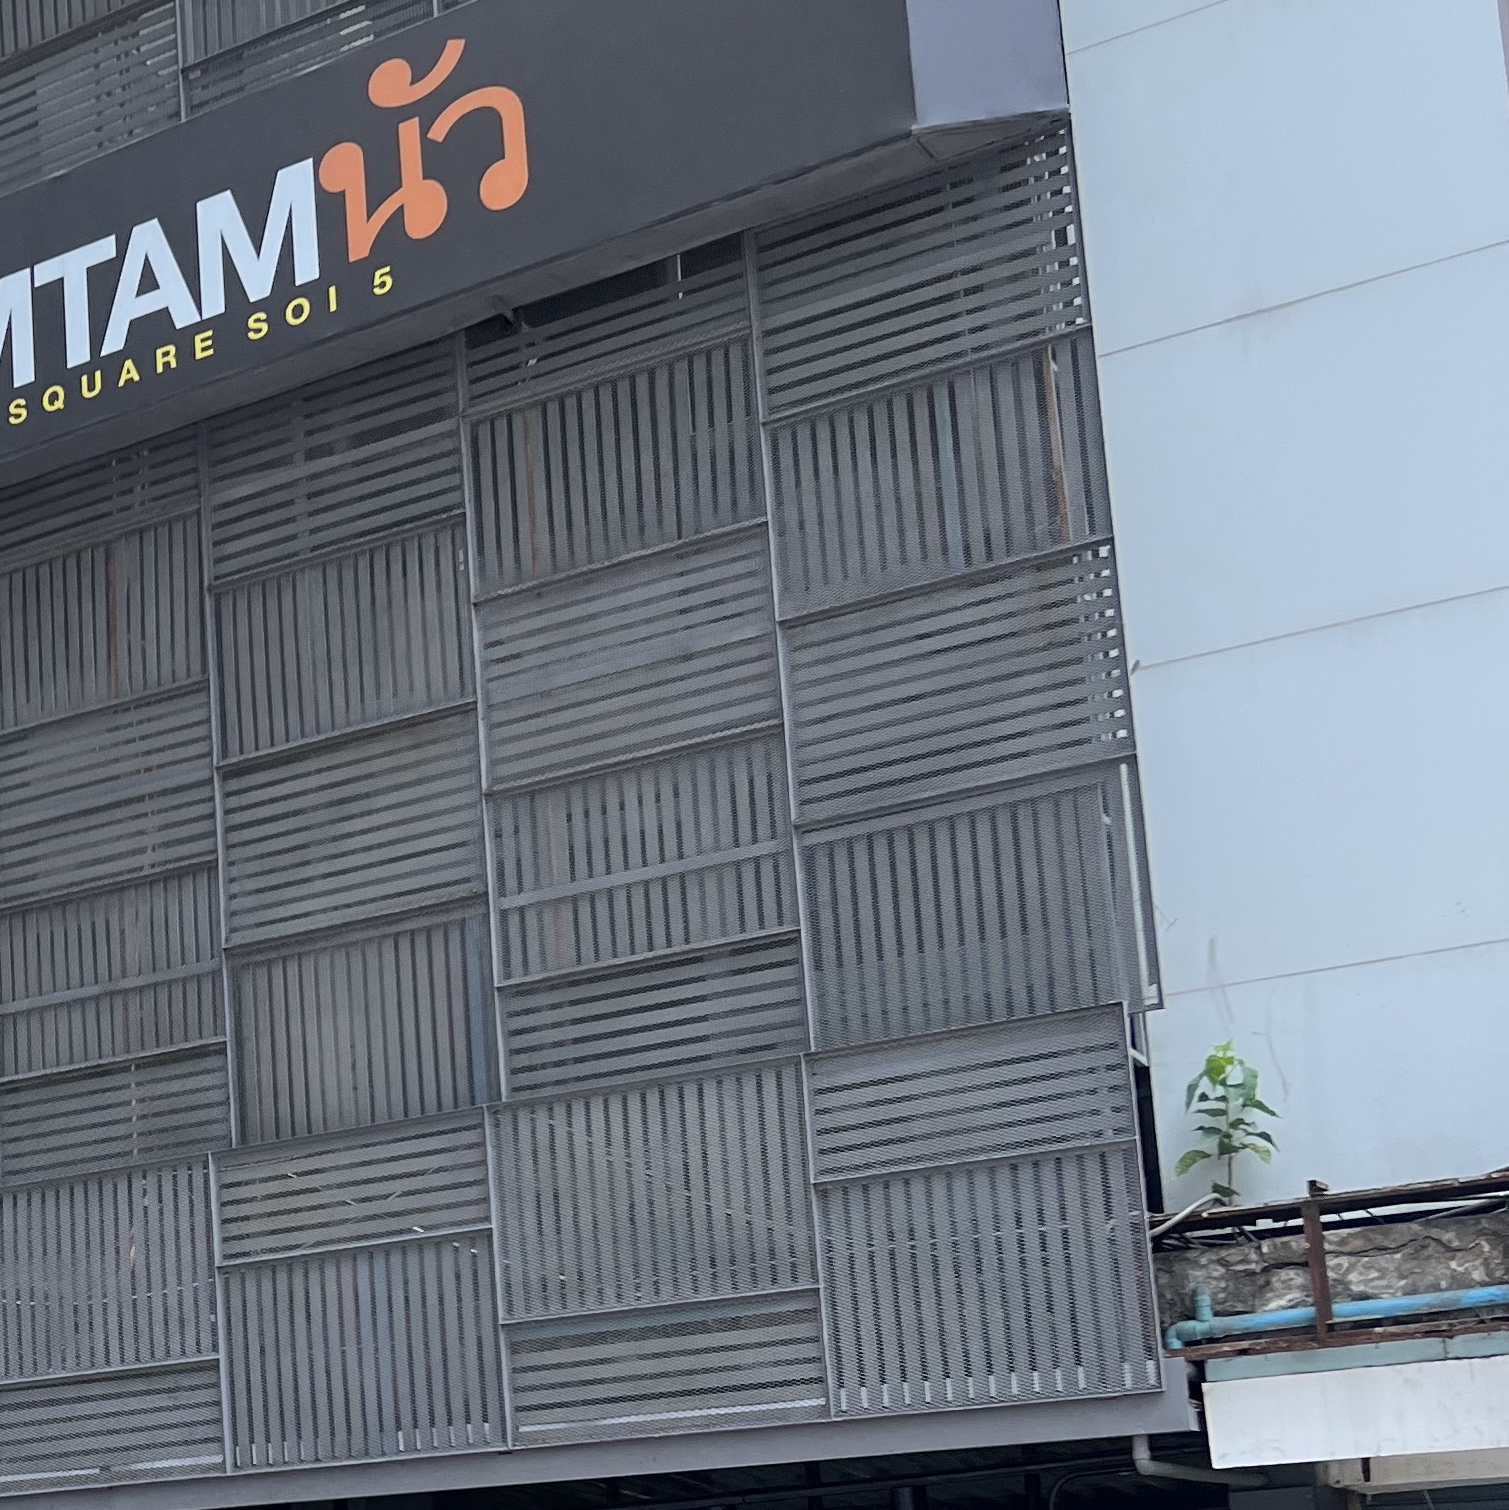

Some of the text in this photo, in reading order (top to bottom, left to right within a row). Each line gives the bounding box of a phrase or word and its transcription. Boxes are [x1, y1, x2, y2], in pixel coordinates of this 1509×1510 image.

[7, 330, 216, 426] SQUARE
[247, 283, 338, 341] SOI
[371, 265, 395, 296] 5
